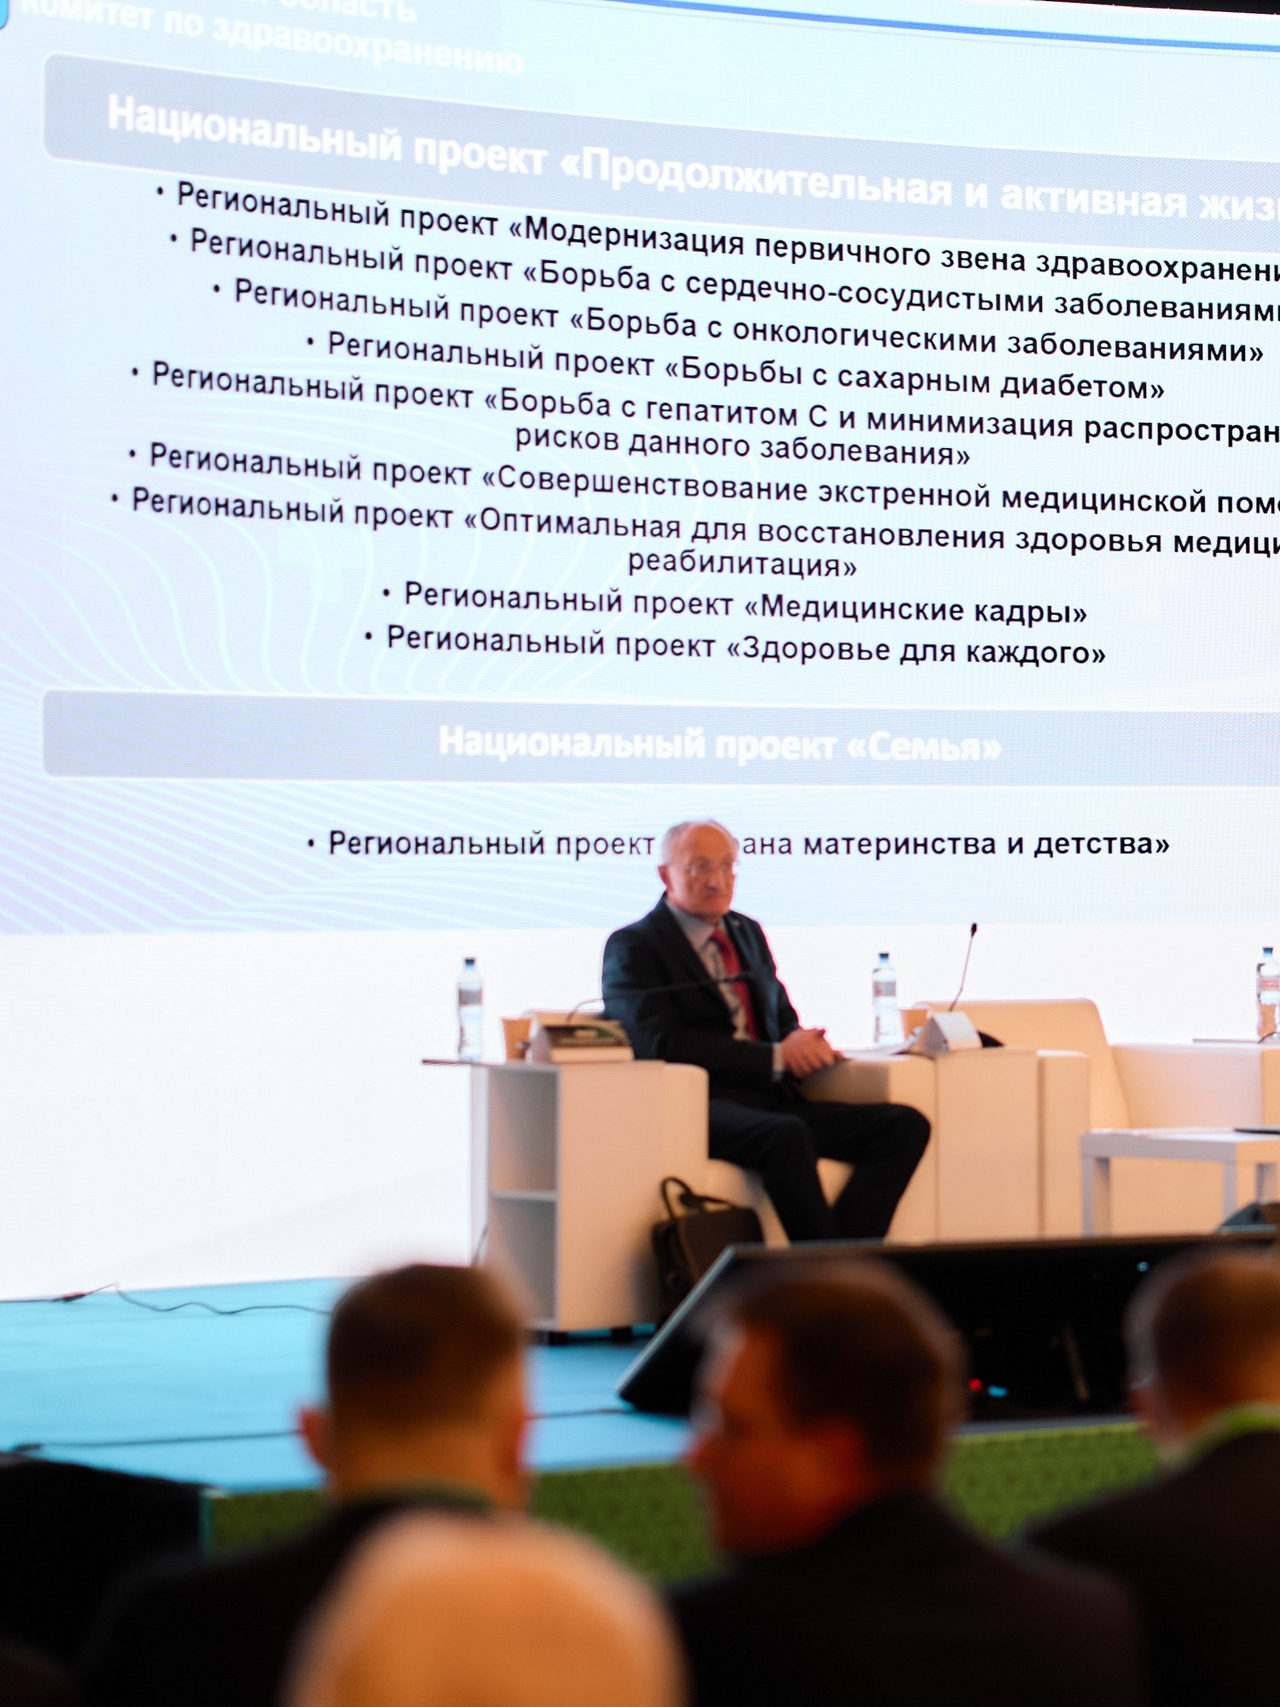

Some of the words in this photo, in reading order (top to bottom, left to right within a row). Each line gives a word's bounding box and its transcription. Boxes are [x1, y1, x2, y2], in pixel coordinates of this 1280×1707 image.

[162, 9, 205, 38] по
[211, 16, 525, 76] здравоохранению
[107, 92, 402, 164] Национальный
[415, 136, 550, 176] проект
[560, 145, 952, 208] «Продолжительная
[964, 181, 989, 209] и
[1000, 181, 1188, 219] активная
[177, 180, 390, 227] Региональный
[400, 208, 499, 237] проект
[508, 214, 744, 258] «Модернизация
[755, 237, 931, 267] первичного
[940, 249, 1026, 272] звена
[191, 226, 404, 272] Региональный
[414, 253, 514, 281] проект
[523, 258, 651, 293] «Борьба
[660, 273, 676, 293] с
[685, 275, 1044, 314] сердечно-сосудистыми
[235, 277, 449, 320] Региональный
[460, 302, 560, 329] проект
[569, 306, 697, 340] «Борьба
[707, 319, 723, 339] с
[732, 321, 997, 354] онкологическими
[1007, 331, 1264, 363] заболеваниями»
[153, 359, 364, 402] Региональный
[374, 383, 475, 410] проект
[484, 386, 611, 420] «Борьба
[621, 399, 636, 419] с
[646, 400, 798, 427] гепатитом
[839, 410, 856, 430] и
[867, 411, 1074, 441] минимизация
[328, 330, 544, 370] Региональный
[555, 351, 656, 379] проект
[665, 354, 802, 388] «Борьбы
[812, 367, 828, 387] с
[837, 368, 991, 397] сахарным
[999, 372, 1165, 400] диабетом»
[150, 441, 362, 481] Региональный
[372, 461, 472, 489] проект
[482, 463, 808, 502] «Совершенствование
[818, 484, 990, 511] экстренной
[1001, 487, 1207, 515] медицинской
[515, 427, 620, 452] рисков
[627, 433, 751, 458] данного
[760, 435, 971, 466] заболевания»
[132, 485, 344, 524] Региональный
[354, 504, 454, 532] проект
[464, 506, 681, 539] «Оптимальная
[690, 520, 747, 544] для
[758, 523, 1005, 550] восстановления
[1015, 530, 1162, 557] здоровья
[628, 548, 858, 581] реабилитация»
[405, 580, 623, 613] Региональный
[633, 594, 735, 620] проект
[744, 592, 965, 624] «Медицинские
[974, 603, 1088, 629] кадры»
[387, 623, 605, 655] Региональный
[616, 636, 717, 662] проект
[726, 634, 891, 666] «Здоровье
[899, 642, 956, 667] для
[966, 644, 1107, 668] каждого»
[439, 724, 706, 763] Национальный
[715, 735, 838, 767] проект
[846, 730, 1001, 761] «Семья»
[329, 829, 545, 856] Региональный
[556, 836, 656, 862] проект
[804, 837, 996, 861] материнства
[1008, 837, 1023, 854] и
[1034, 837, 1169, 858] детства»
